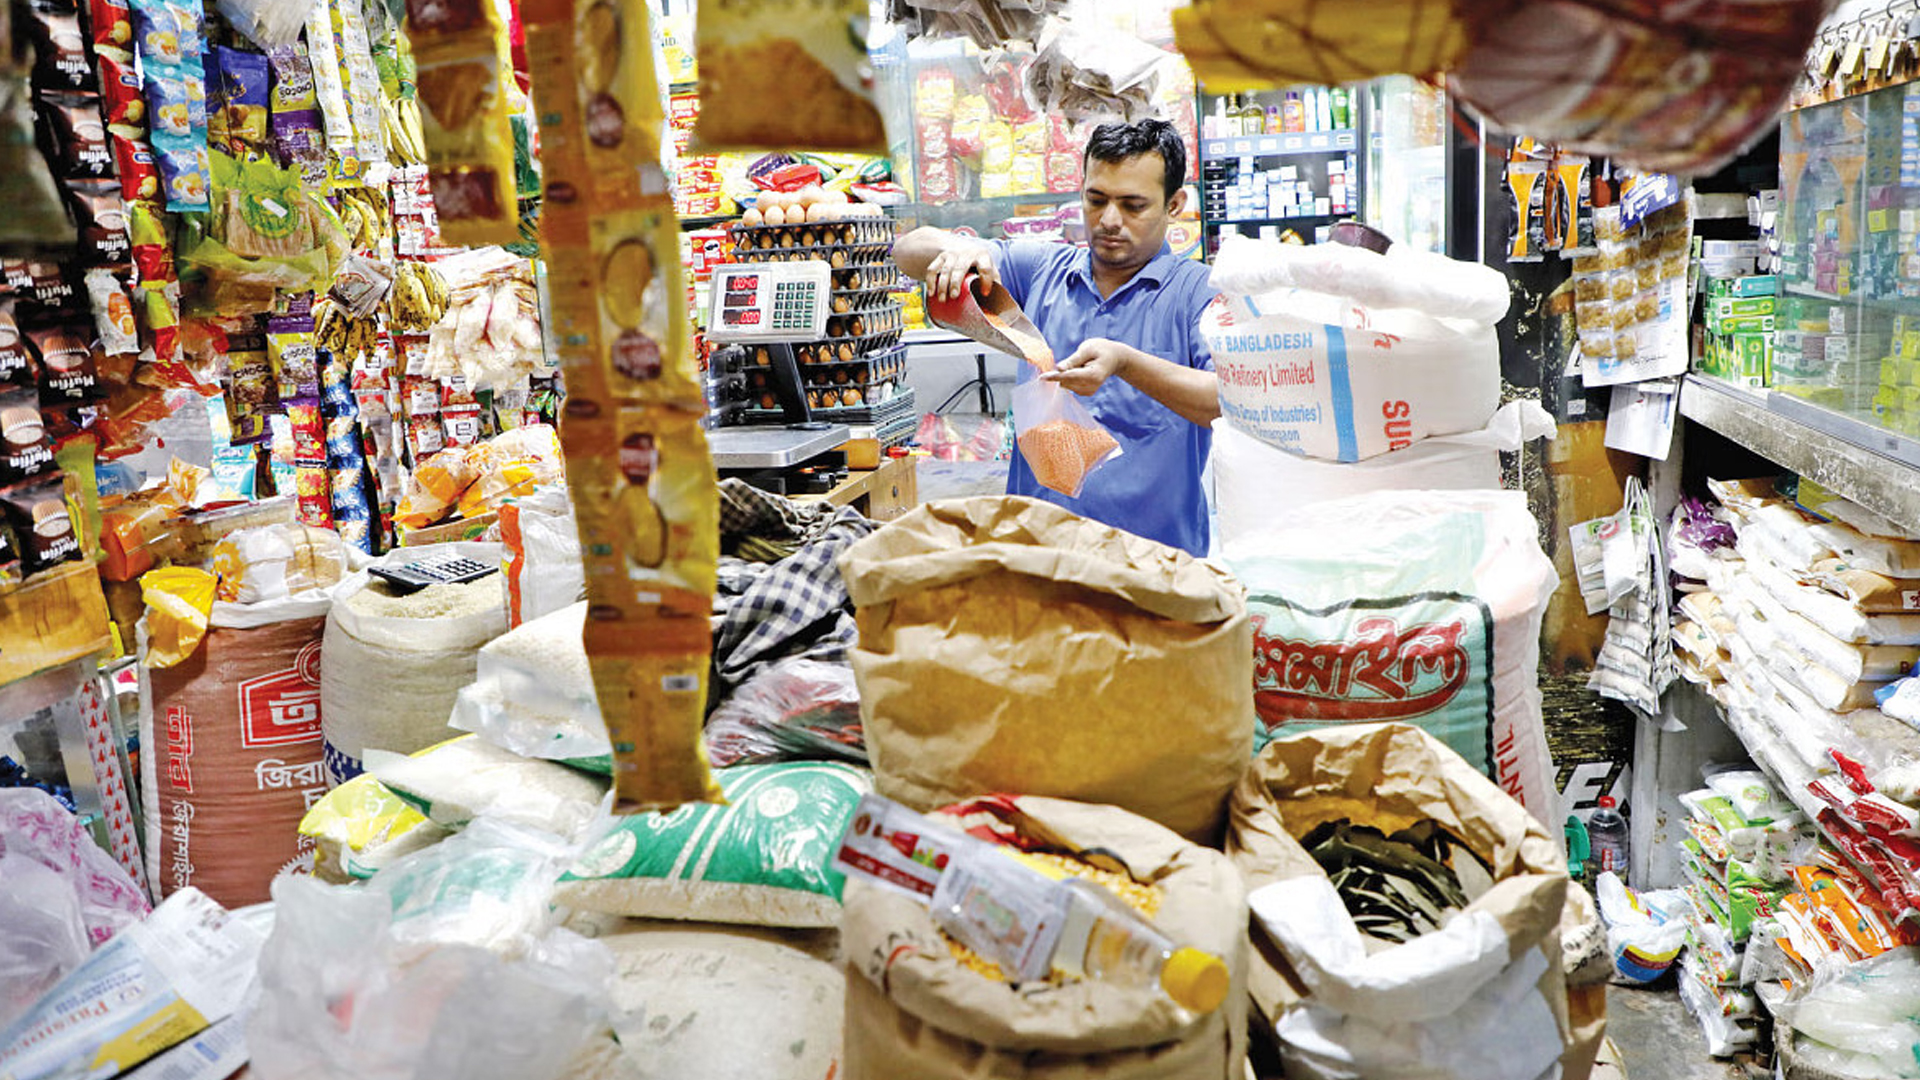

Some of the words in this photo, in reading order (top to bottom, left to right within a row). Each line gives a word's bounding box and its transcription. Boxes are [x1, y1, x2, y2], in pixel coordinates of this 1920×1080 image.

[36, 285, 73, 299] Muffi
[1225, 332, 1313, 353] BANGLADESH
[0, 356, 25, 370] Muf
[233, 364, 271, 379] CHOCO
[49, 375, 95, 390] Muffin
[1269, 360, 1315, 388] Limited
[10, 448, 52, 468] Muffin
[166, 705, 194, 793] তীর
[1496, 723, 1527, 808] NTIL
